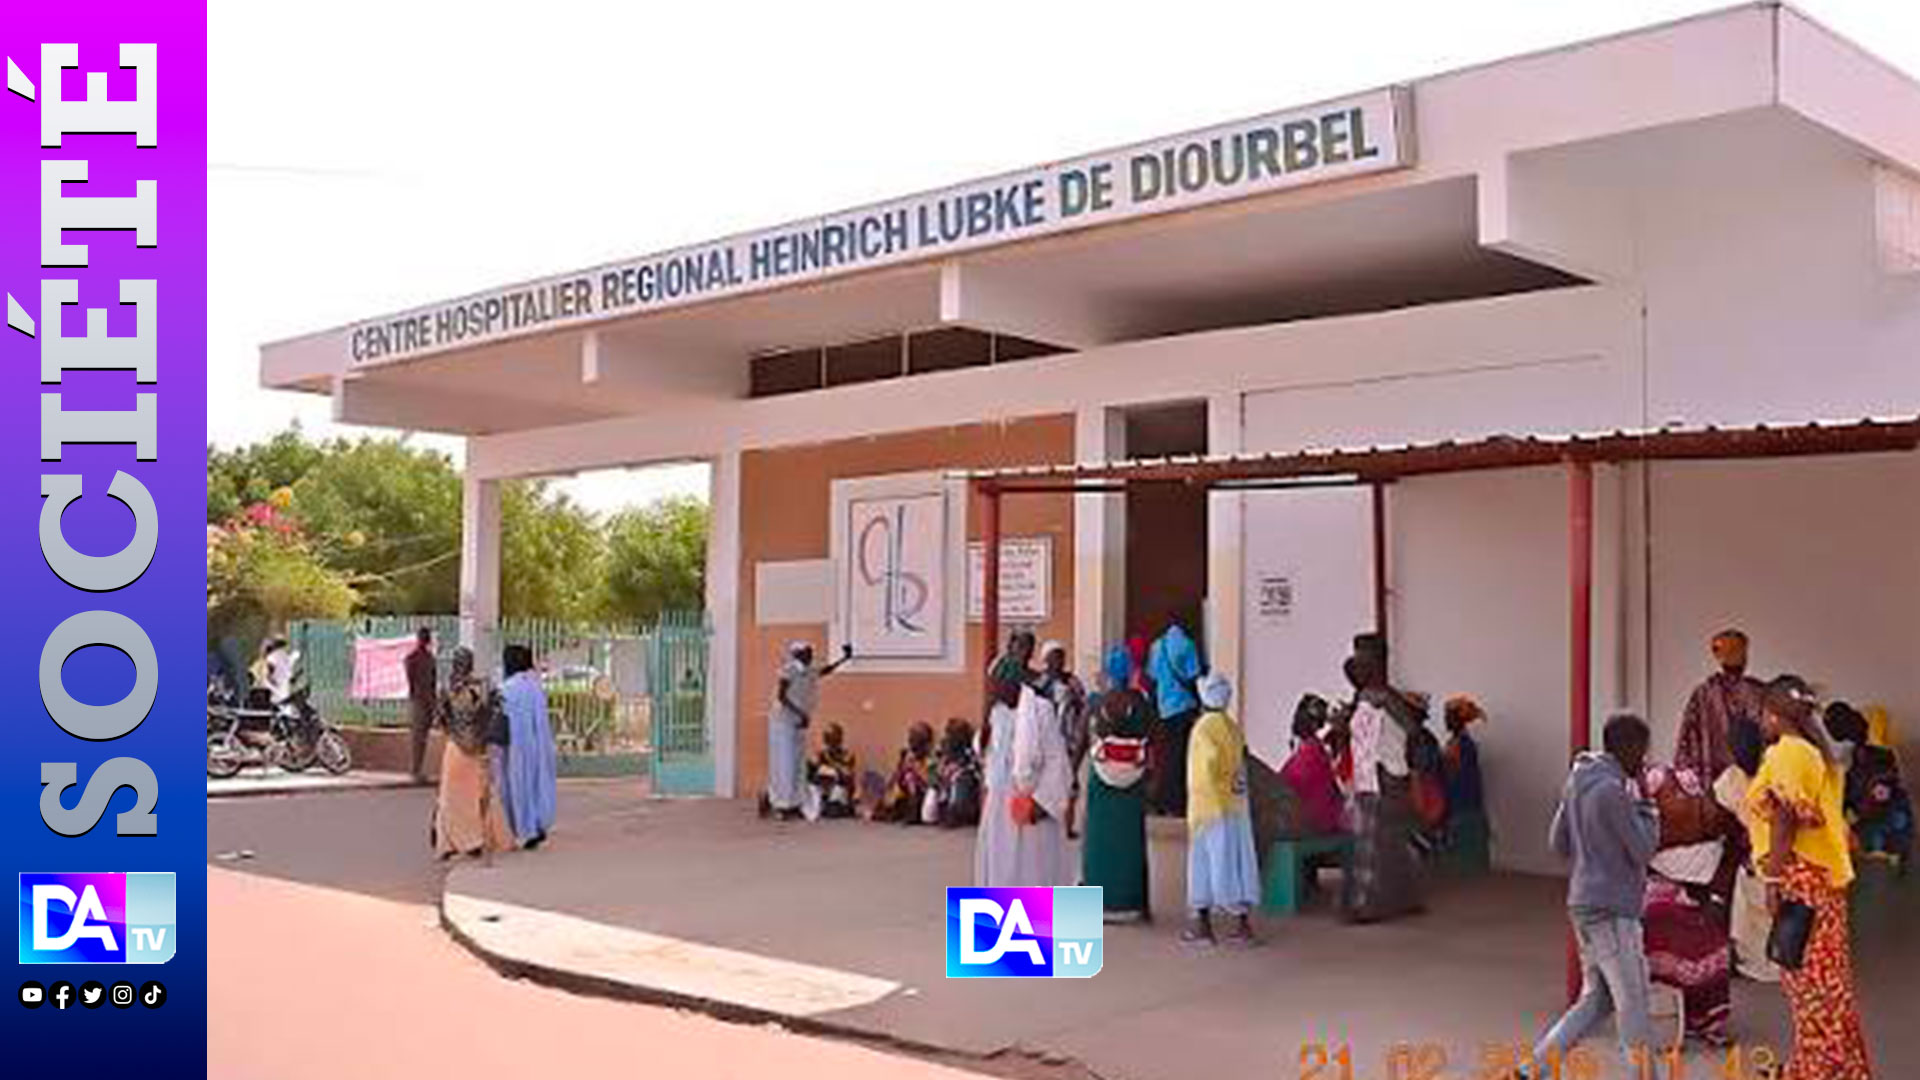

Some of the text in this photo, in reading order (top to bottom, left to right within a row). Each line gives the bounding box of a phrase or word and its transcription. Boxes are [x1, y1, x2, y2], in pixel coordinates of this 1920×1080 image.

[351, 107, 1379, 361] CENTRE HOSPITALIER REGIONAL HEINRICH LUBKE DE DIOURBEL
